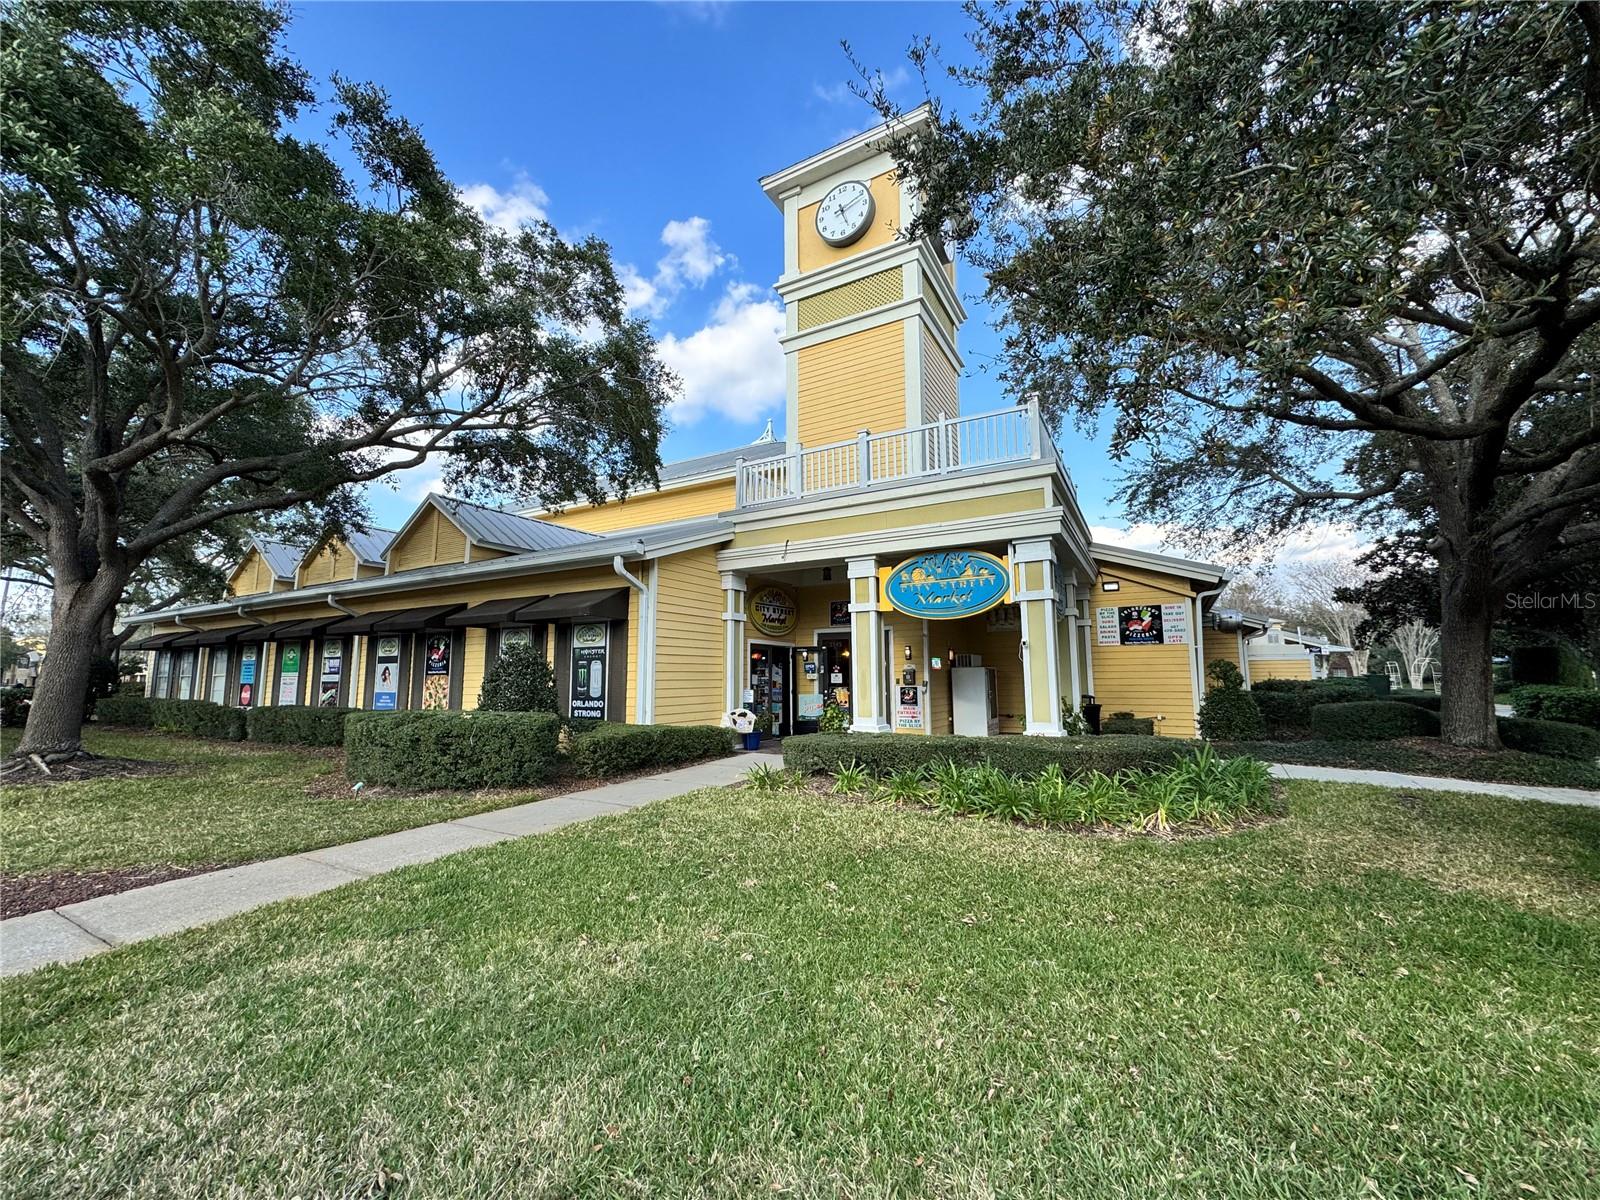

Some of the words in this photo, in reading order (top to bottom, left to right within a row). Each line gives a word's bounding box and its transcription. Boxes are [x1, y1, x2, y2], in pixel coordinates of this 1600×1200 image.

[838, 186, 848, 194] 12
[900, 582, 930, 592] CITY
[940, 578, 995, 589] STREET
[913, 589, 973, 605] Market
[772, 608, 794, 616] STREET
[762, 613, 787, 625] Market
